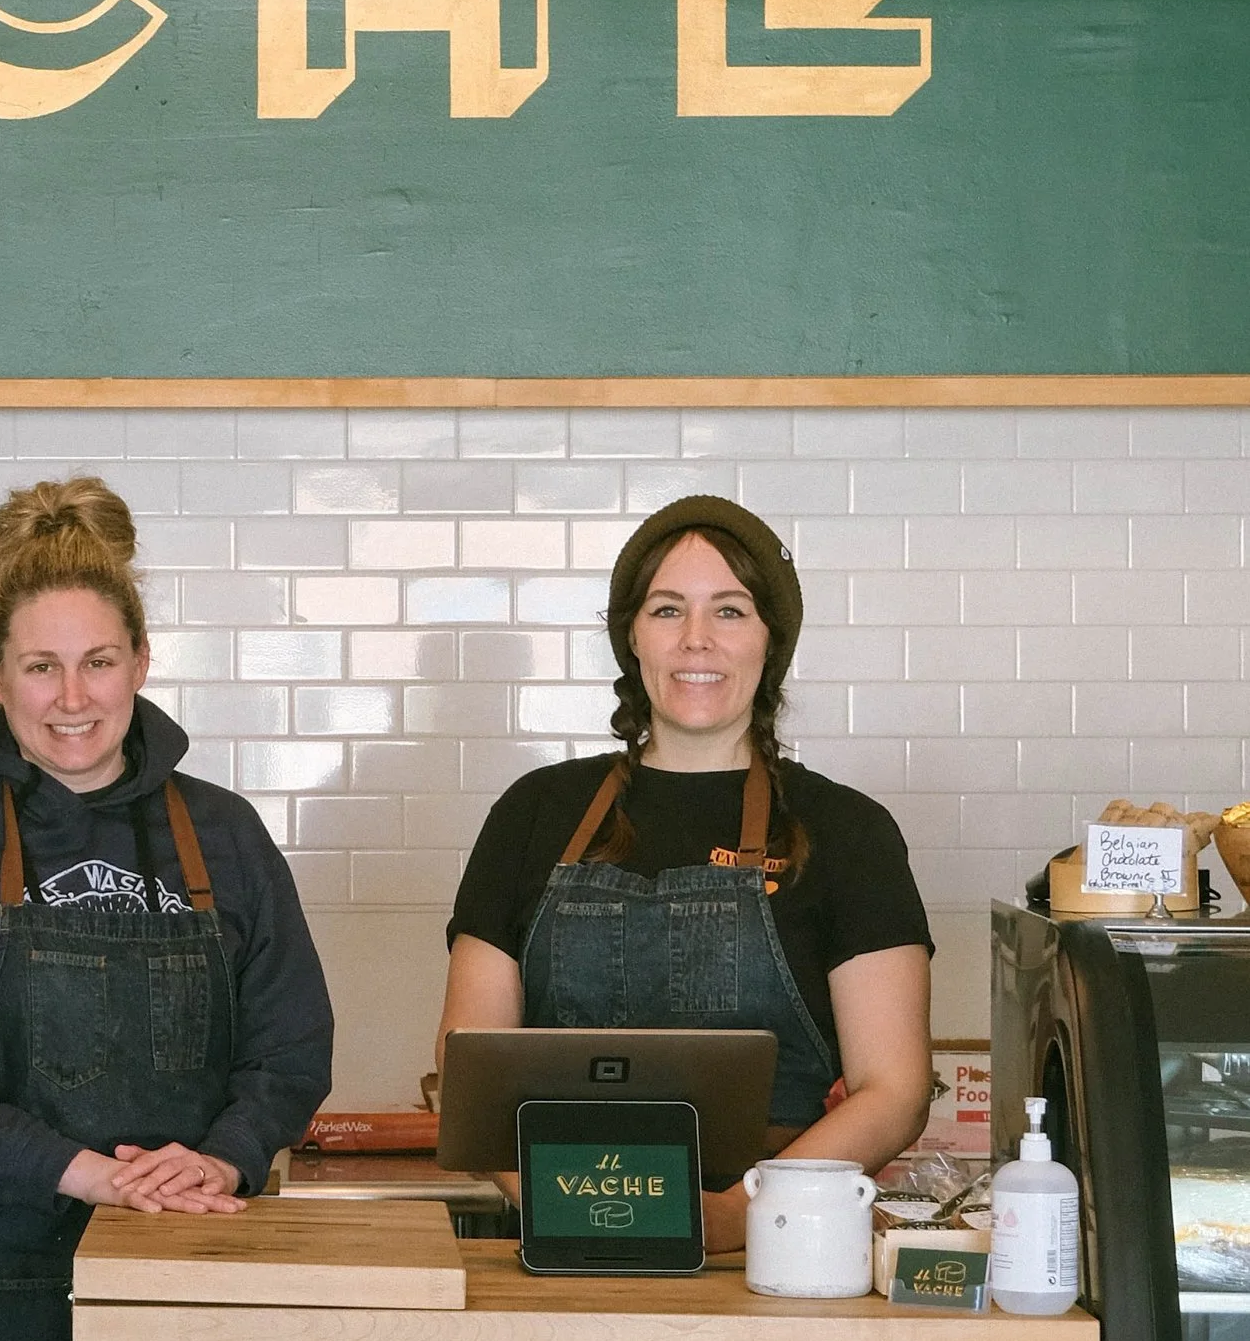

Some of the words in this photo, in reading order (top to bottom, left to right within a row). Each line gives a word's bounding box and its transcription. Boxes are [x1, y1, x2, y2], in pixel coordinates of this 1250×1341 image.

[1100, 830, 1159, 858] Belgian
[956, 1087, 991, 1102] Foo
[556, 1175, 666, 1196] VACHE
[913, 1283, 965, 1297] VACHE
